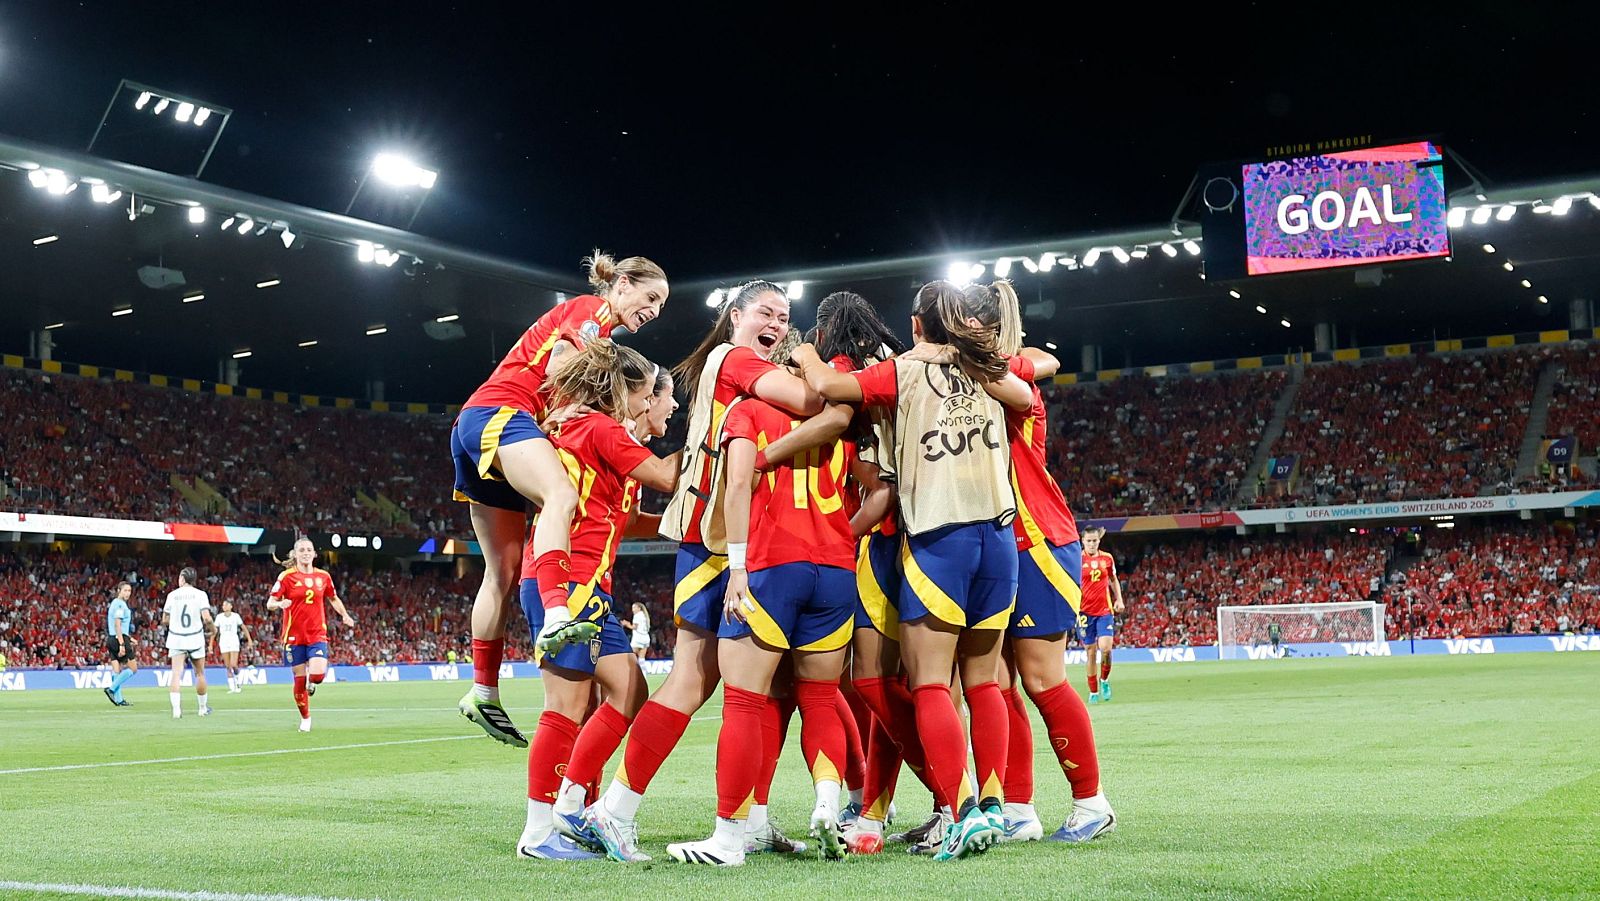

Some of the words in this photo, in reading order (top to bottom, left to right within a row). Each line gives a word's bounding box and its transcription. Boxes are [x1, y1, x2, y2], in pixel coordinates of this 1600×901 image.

[1276, 183, 1413, 235] GOAL
[1553, 447, 1568, 456] D9
[790, 420, 843, 515] 10
[1277, 465, 1290, 474] D7
[1306, 509, 1330, 518] UEFA
[1332, 506, 1373, 517] WOMEN'S
[1375, 505, 1400, 514] EURO
[1402, 500, 1468, 513] SWITZERLAND
[1470, 499, 1495, 509] 2025
[1090, 569, 1101, 582] 12
[305, 589, 315, 604] 2
[180, 604, 192, 628] 6
[1341, 642, 1393, 656] VISA
[1442, 638, 1495, 654] VISA
[1548, 635, 1600, 651] VISA
[1149, 647, 1196, 662] VISA
[367, 666, 399, 682] VISA
[429, 665, 459, 680] VISA
[644, 660, 674, 674] VIS
[70, 671, 113, 688] VISA
